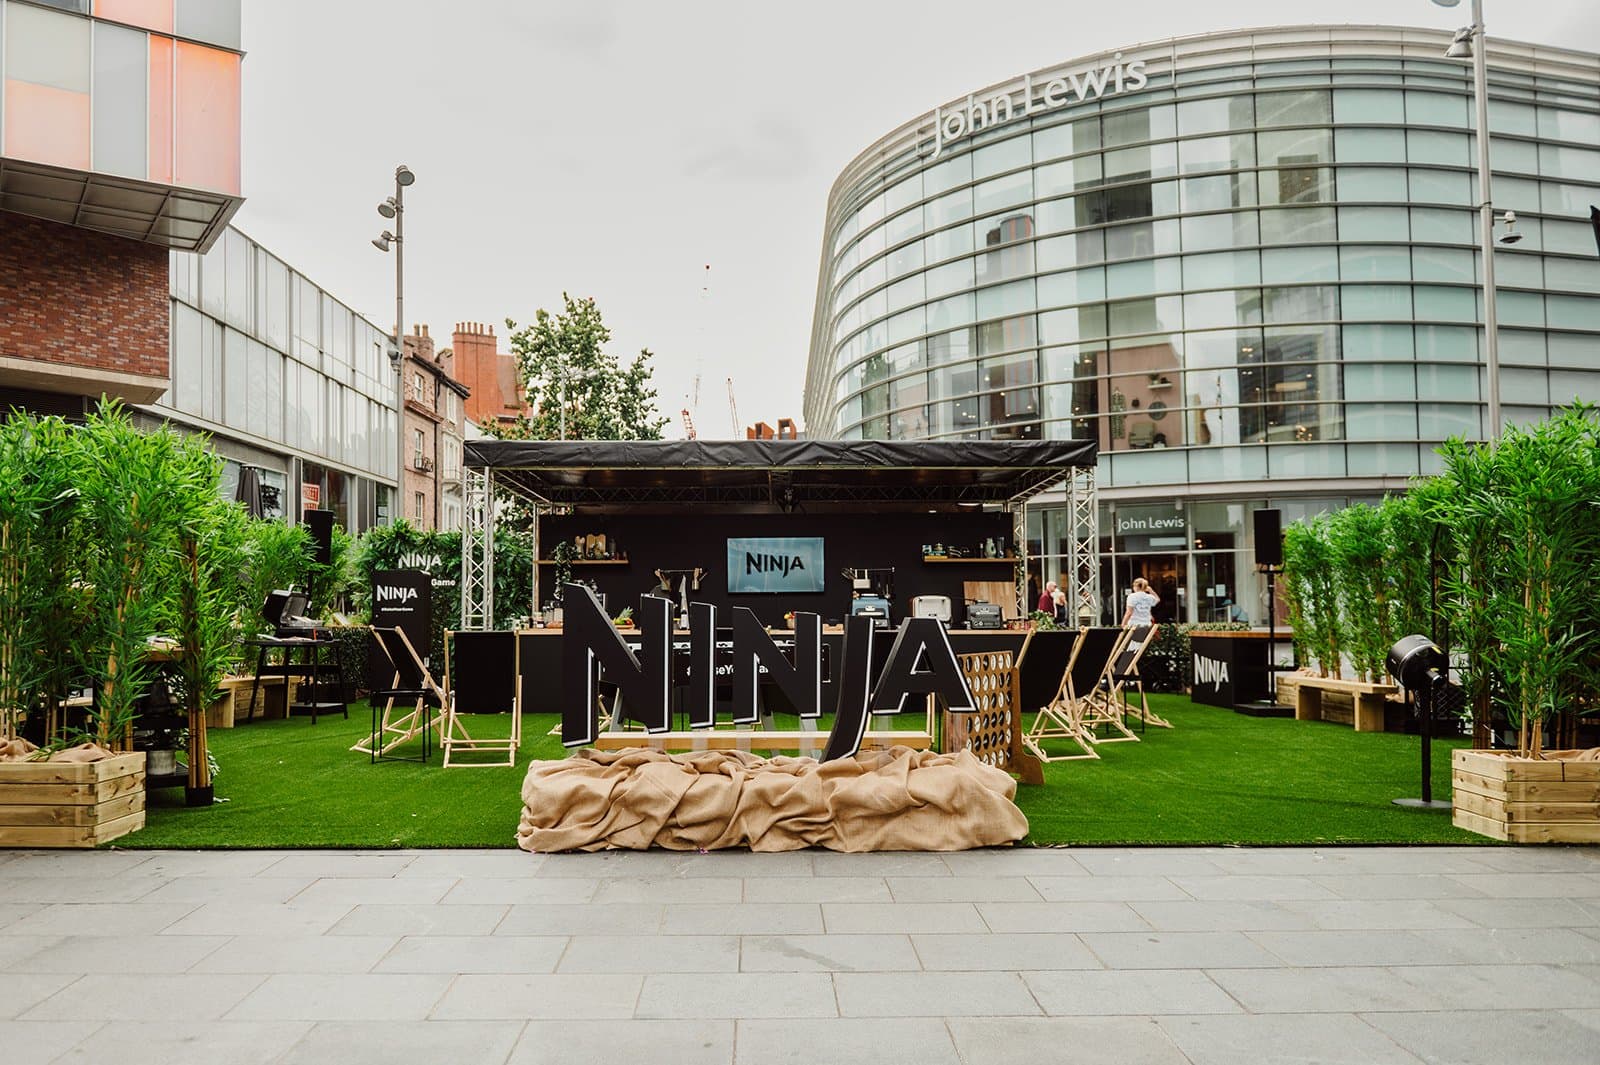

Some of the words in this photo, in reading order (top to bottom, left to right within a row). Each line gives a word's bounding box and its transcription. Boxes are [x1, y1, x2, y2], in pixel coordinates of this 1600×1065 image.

[932, 94, 1013, 158] John
[1024, 52, 1148, 115] Lewis
[1118, 517, 1146, 532] John
[1149, 516, 1185, 529] Lewis
[398, 552, 442, 571] NINJA
[746, 551, 805, 578] NINJA
[376, 584, 418, 604] NINJA
[562, 582, 978, 764] NINJA
[1194, 652, 1229, 692] NINJA
